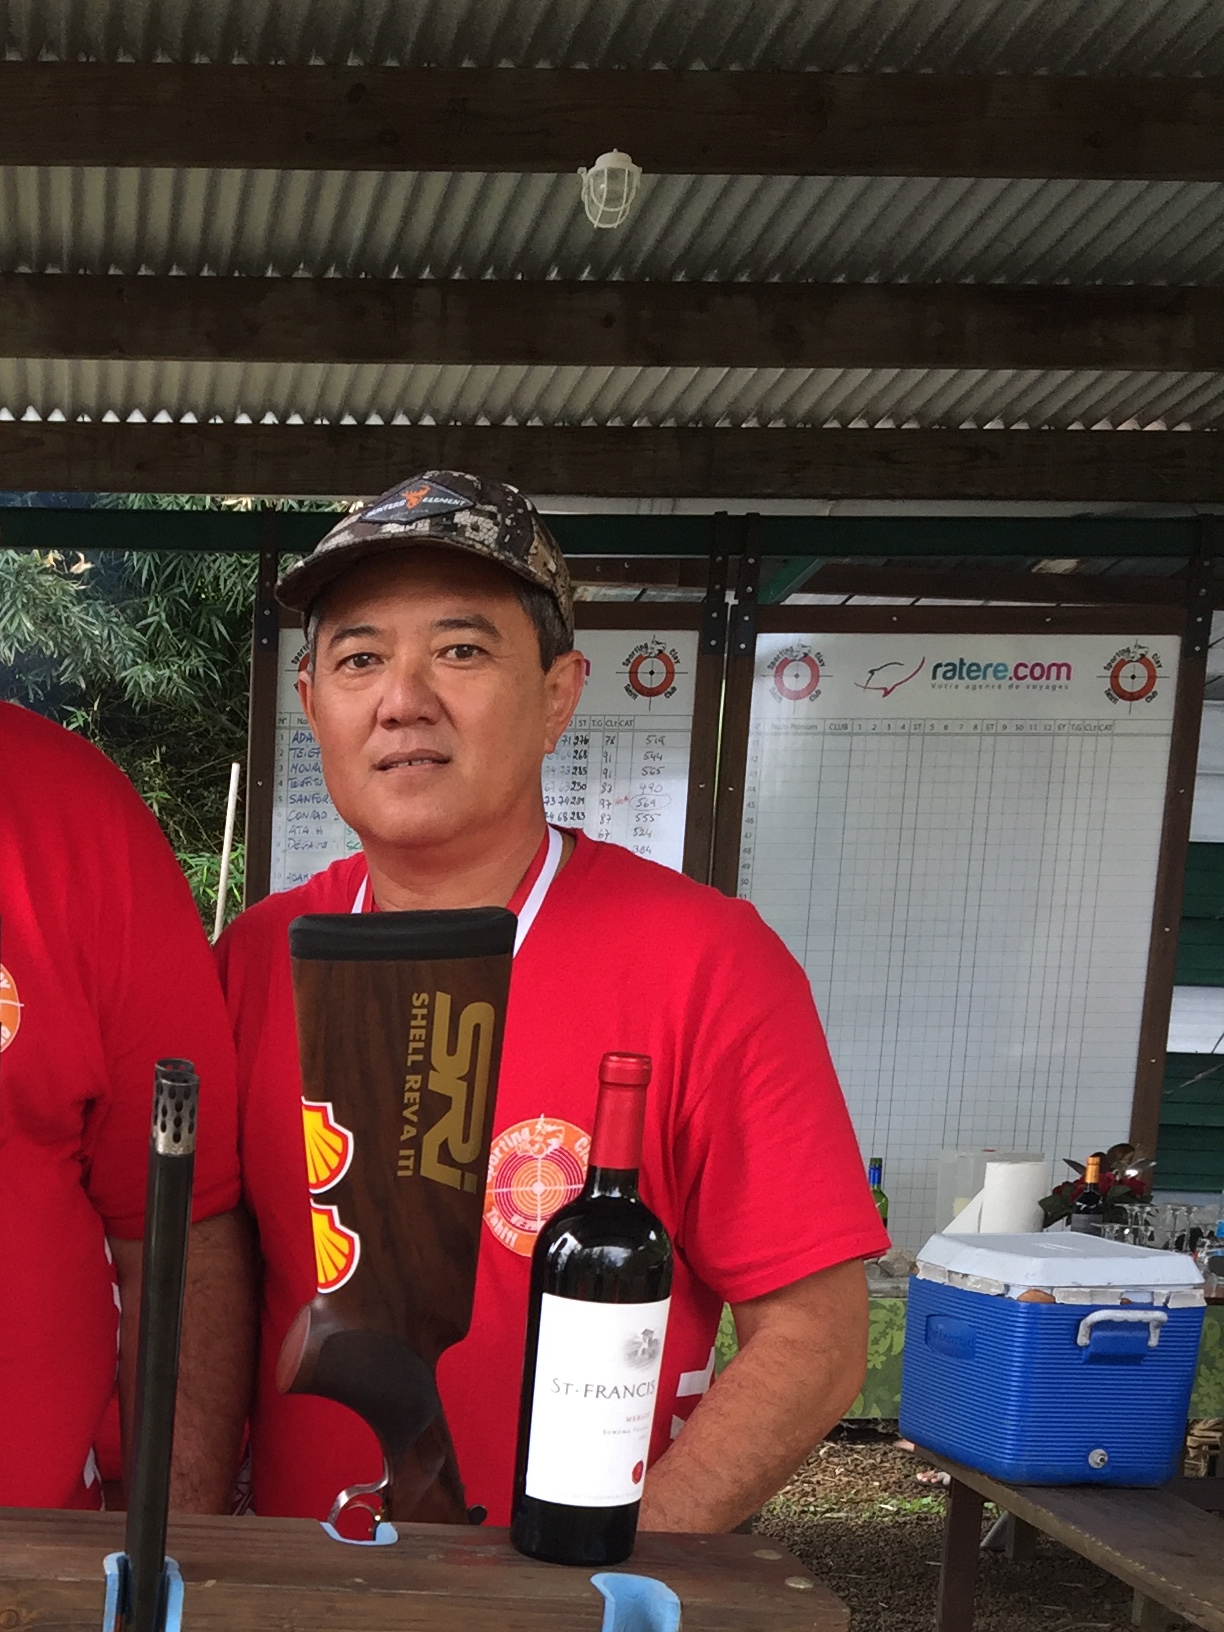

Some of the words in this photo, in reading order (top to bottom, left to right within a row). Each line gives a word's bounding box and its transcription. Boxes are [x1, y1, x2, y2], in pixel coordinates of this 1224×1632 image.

[422, 496, 467, 507] ELEMENT
[622, 642, 649, 667] Sporting
[669, 648, 681, 665] Clay
[767, 645, 794, 670] Sporting
[815, 651, 826, 667] Clay
[1103, 646, 1131, 671] Sporting
[1152, 652, 1163, 669] Clay
[931, 657, 1073, 682] ratere.com
[663, 685, 677, 699] Club
[930, 682, 960, 690] Votre
[964, 683, 1002, 692] agence
[1008, 682, 1020, 690] de
[1027, 683, 1070, 692] voyages
[809, 689, 822, 702] Club
[1145, 690, 1158, 703] Club
[578, 719, 588, 727] ST
[619, 719, 634, 727] CAT
[829, 722, 849, 731] CLUB
[1029, 723, 1038, 731] 11
[1098, 723, 1113, 732] CAT
[572, 749, 589, 761] 268
[602, 749, 613, 763] 91
[643, 750, 664, 761] 544
[572, 765, 588, 776] 285
[641, 765, 665, 777] 565
[289, 792, 334, 806] SANFOR
[746, 801, 756, 810] 45
[287, 809, 328, 823] CONRAD
[557, 811, 569, 823] 68
[635, 813, 662, 823] 555
[745, 816, 755, 825] 46
[288, 825, 310, 836] ATA
[632, 826, 653, 838] 524
[743, 831, 753, 840] 47
[742, 847, 752, 855] 48
[741, 862, 751, 870] 49
[740, 877, 750, 886] 50
[406, 991, 430, 1067] SHELL
[399, 1074, 423, 1142] REVA
[396, 1149, 415, 1177] ITI
[486, 1206, 519, 1249] Tahiti
[583, 1379, 656, 1400] FRANCIS
